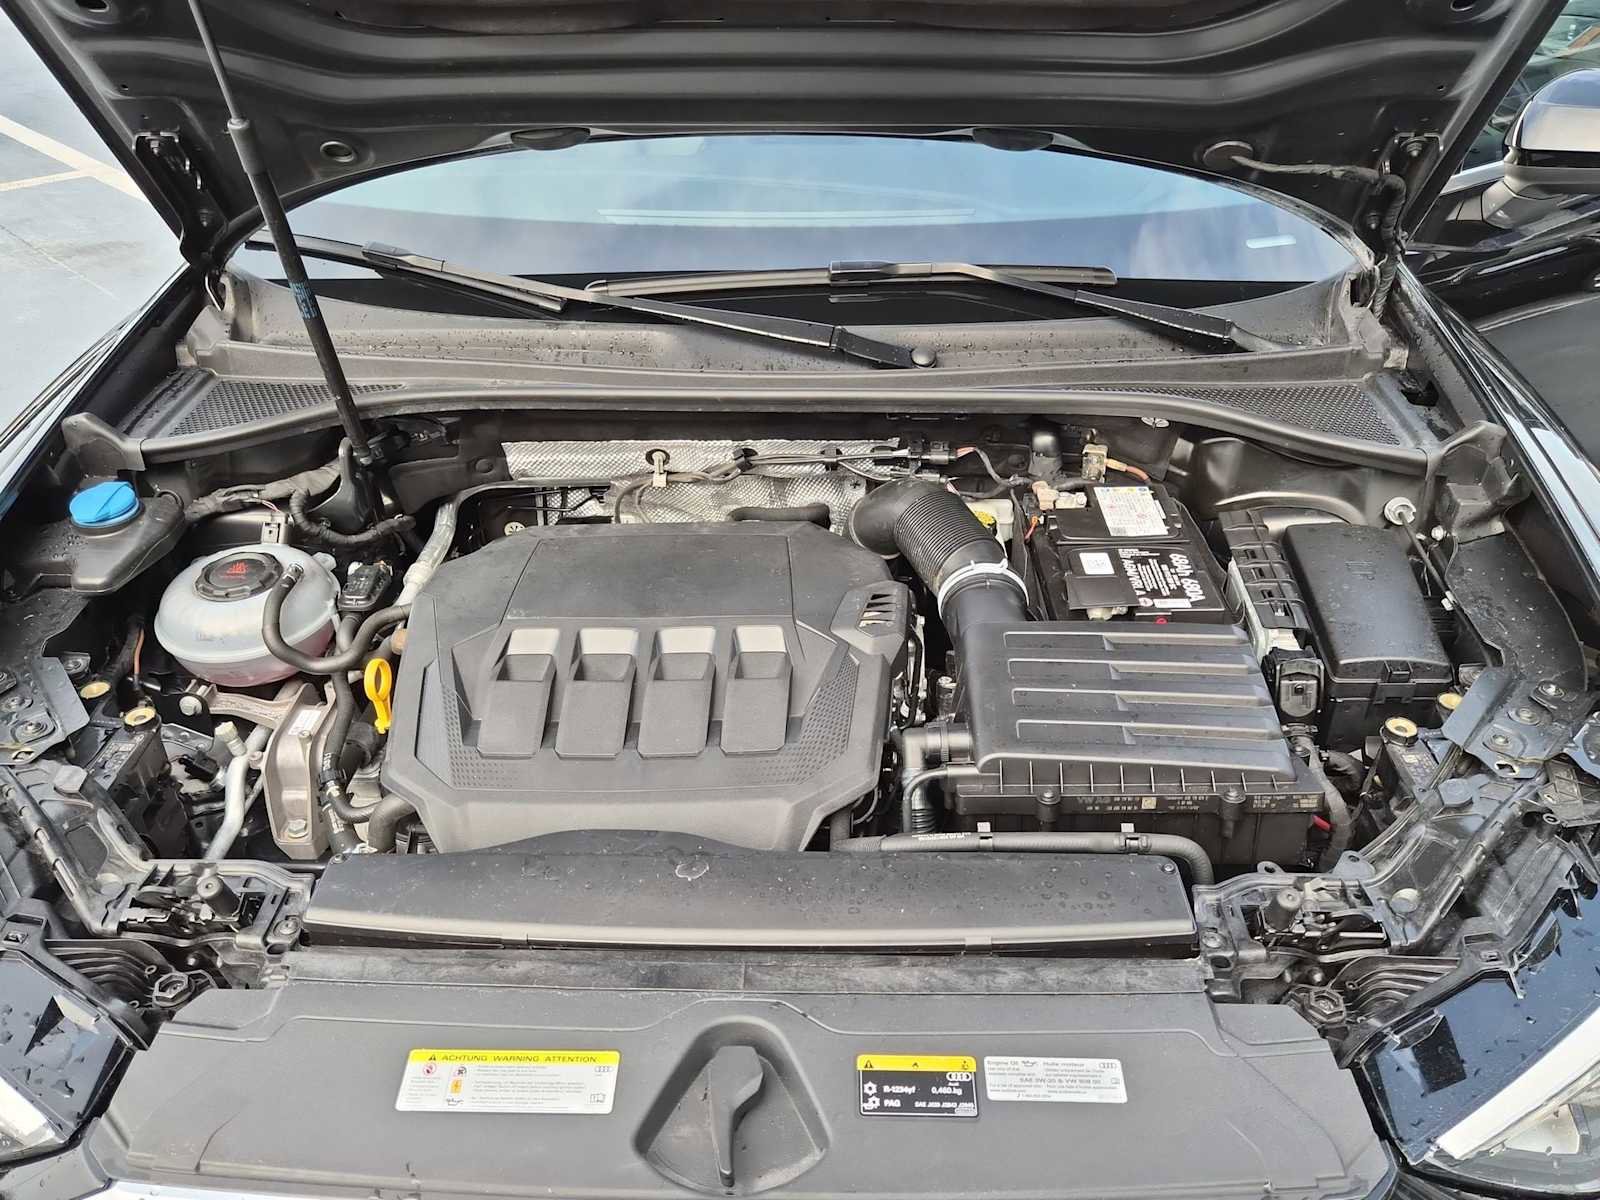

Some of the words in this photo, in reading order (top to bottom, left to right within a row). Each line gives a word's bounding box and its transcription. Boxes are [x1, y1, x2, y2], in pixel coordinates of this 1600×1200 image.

[1169, 553, 1194, 577] 68Ah
[1180, 578, 1206, 602] 680A
[493, 1055, 540, 1063] WARNING
[544, 1056, 598, 1064] ATTENTION
[883, 1099, 901, 1108] PAG
